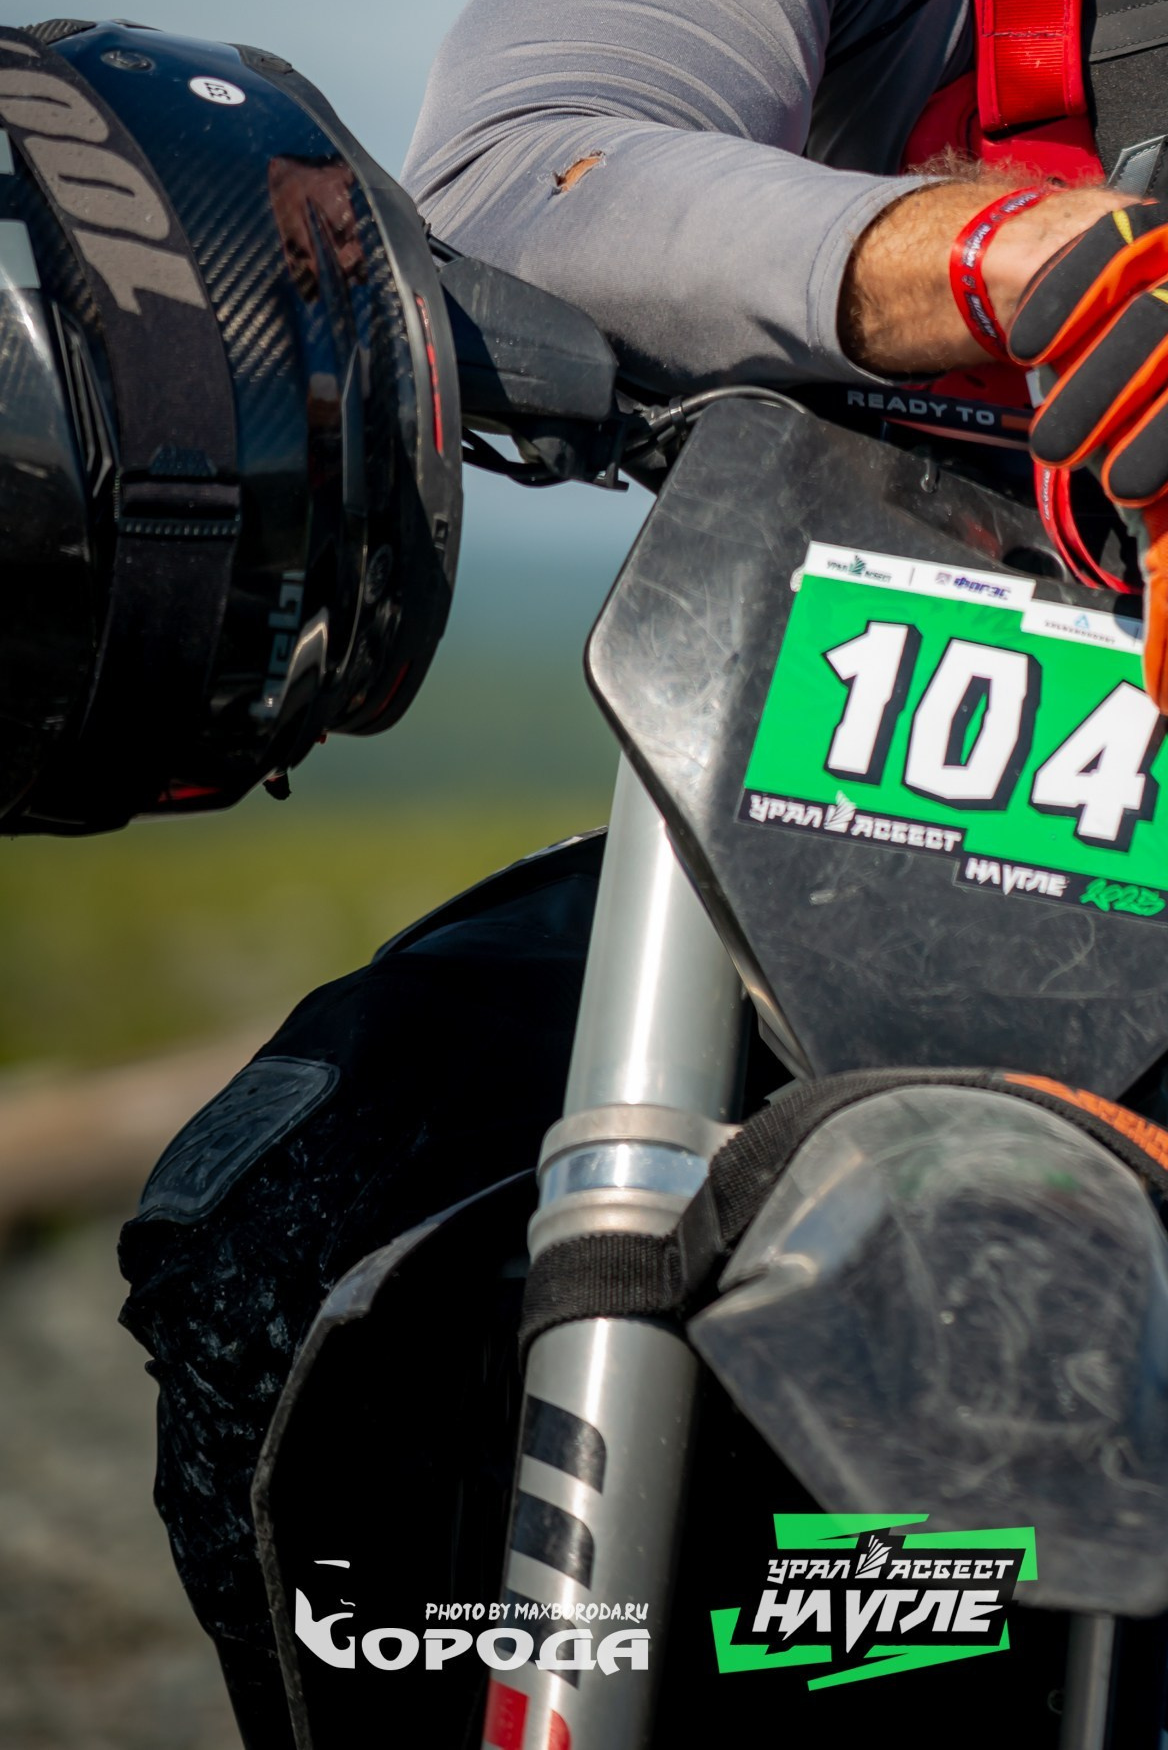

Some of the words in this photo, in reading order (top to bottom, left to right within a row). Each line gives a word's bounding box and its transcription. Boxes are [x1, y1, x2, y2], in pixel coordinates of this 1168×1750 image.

[847, 390, 947, 418] READY
[956, 406, 995, 426] TO
[823, 621, 1159, 851] 104
[749, 794, 823, 829] УРАЛ
[851, 814, 962, 851] АСБЕСТ
